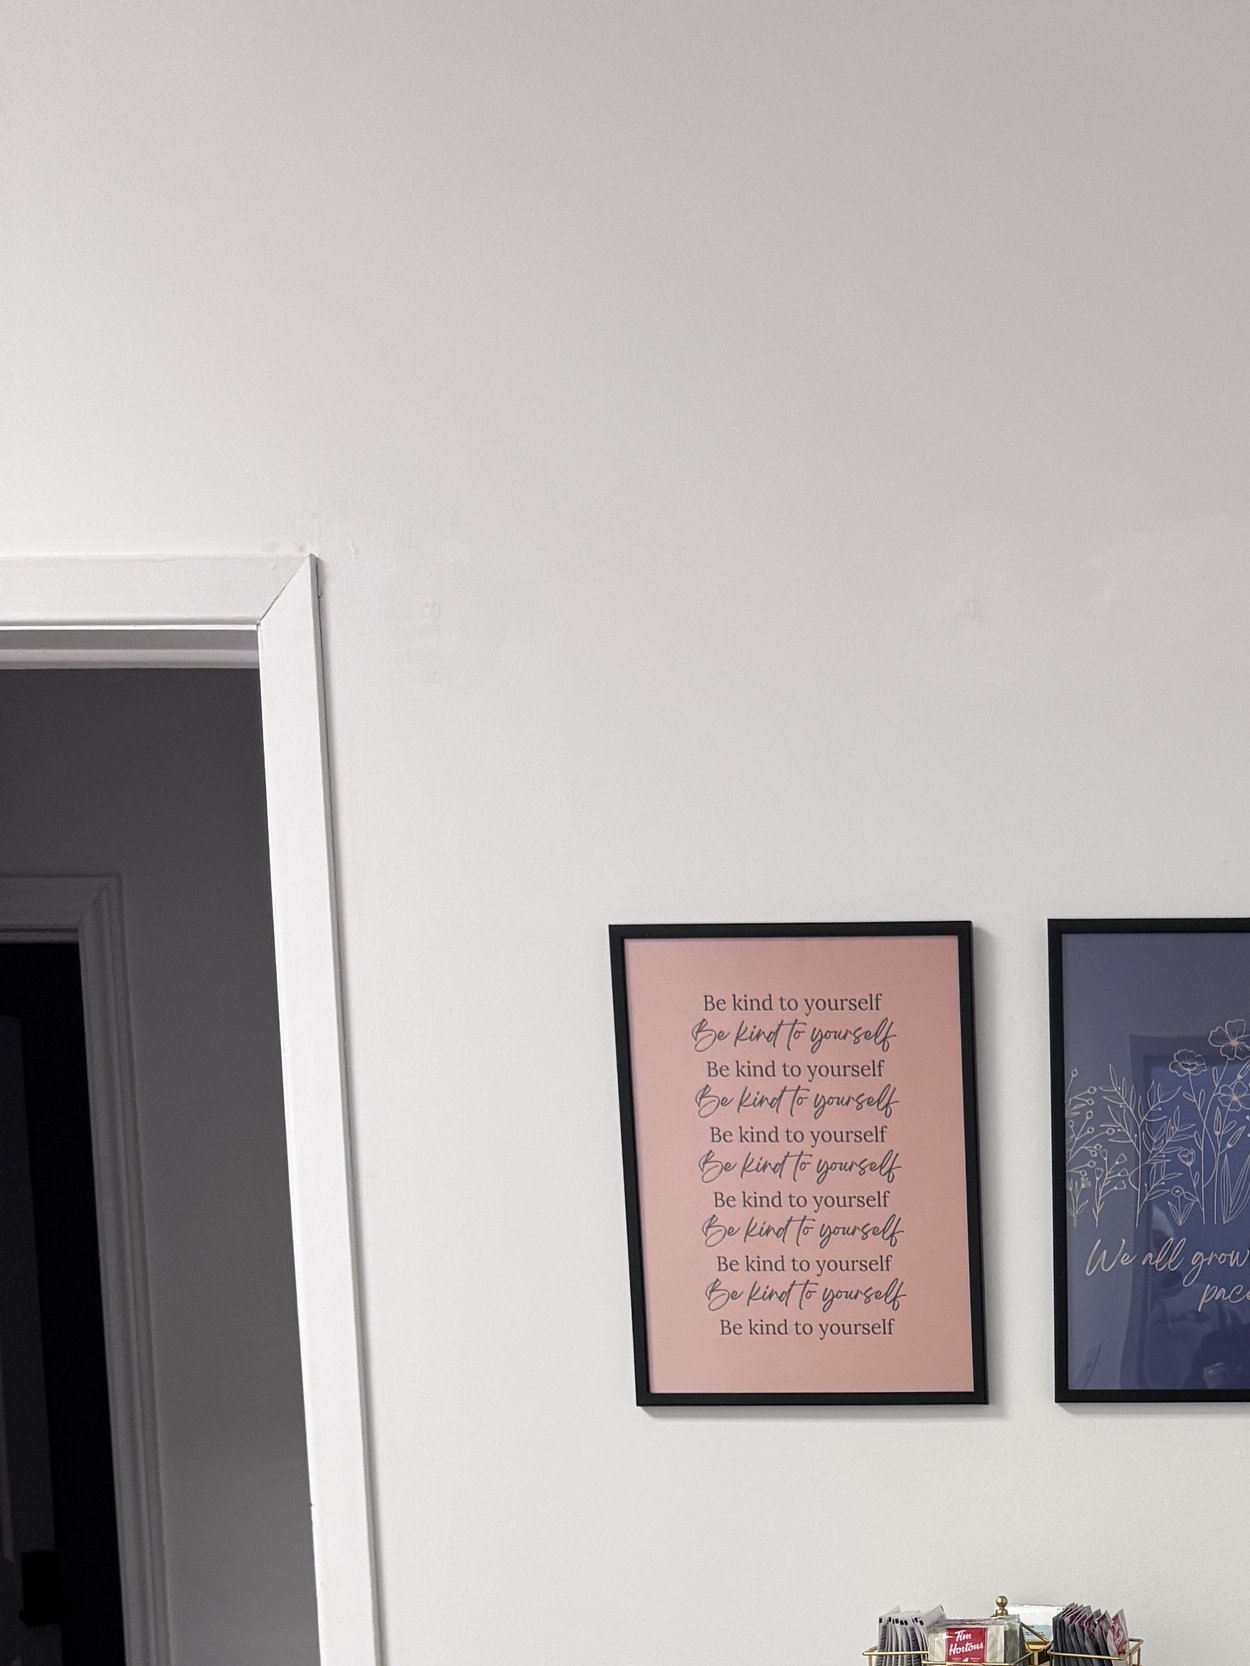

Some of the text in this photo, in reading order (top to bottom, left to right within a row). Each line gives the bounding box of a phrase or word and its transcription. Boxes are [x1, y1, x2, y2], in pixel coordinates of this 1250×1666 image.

[703, 993, 883, 1016] Be kind to yourself
[691, 1017, 897, 1053] Be kind to yourself
[707, 1059, 885, 1082] Be kind to yourself
[695, 1083, 900, 1120] Be kind to yourself
[710, 1125, 888, 1148] Be kind to yourself
[698, 1149, 902, 1185] Be kind to yourself
[713, 1190, 891, 1213] Be kind to yourself
[702, 1213, 904, 1249] Be kind to yourself
[717, 1254, 893, 1277] Be kind to yourself
[1085, 1238, 1137, 1276] We
[1141, 1237, 1188, 1271] all
[1183, 1248, 1250, 1287] grow
[705, 1277, 908, 1313] Be kind to yourself
[720, 1318, 896, 1341] Be kind to yourself
[955, 1629, 972, 1642] Tim
[949, 1641, 984, 1656] Hortons
